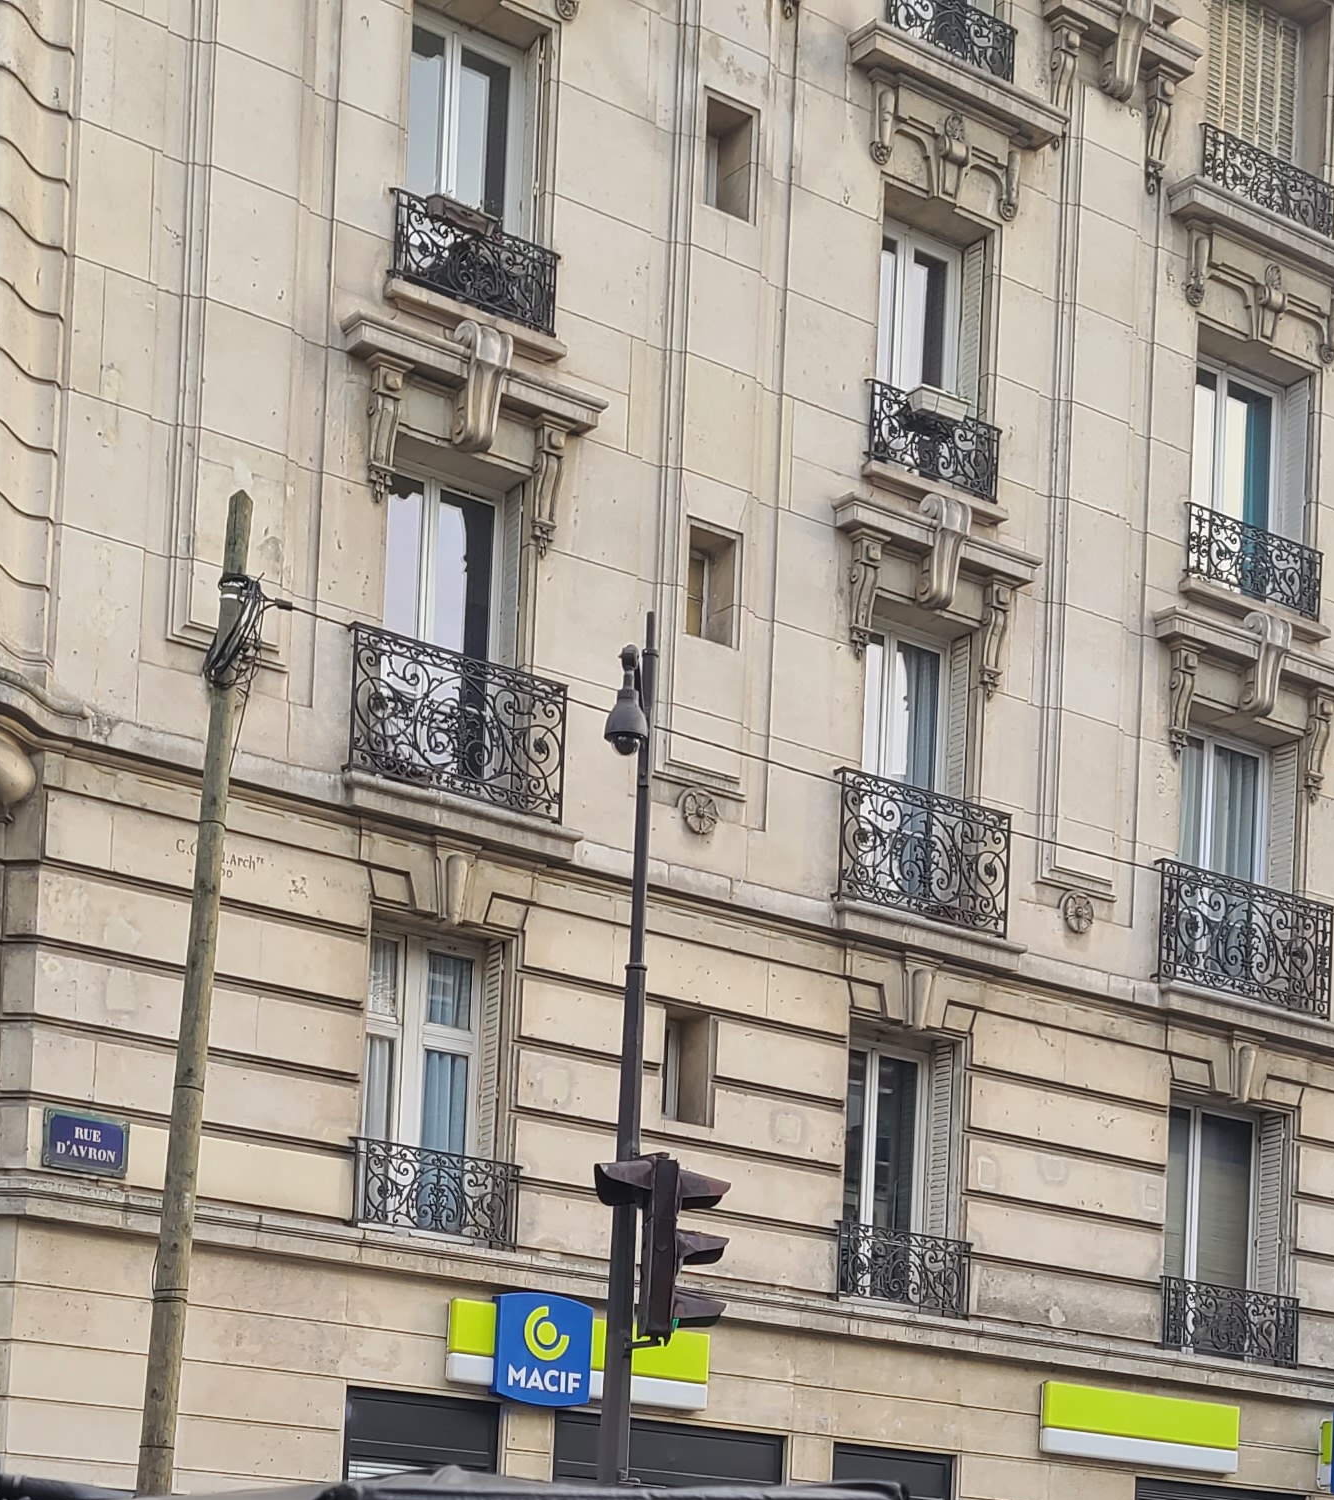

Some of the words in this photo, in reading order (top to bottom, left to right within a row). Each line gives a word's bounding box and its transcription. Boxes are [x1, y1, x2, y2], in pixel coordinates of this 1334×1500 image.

[74, 1126, 102, 1142] RUE
[56, 1140, 116, 1163] D'AVRON
[507, 1363, 582, 1394] MACIF
